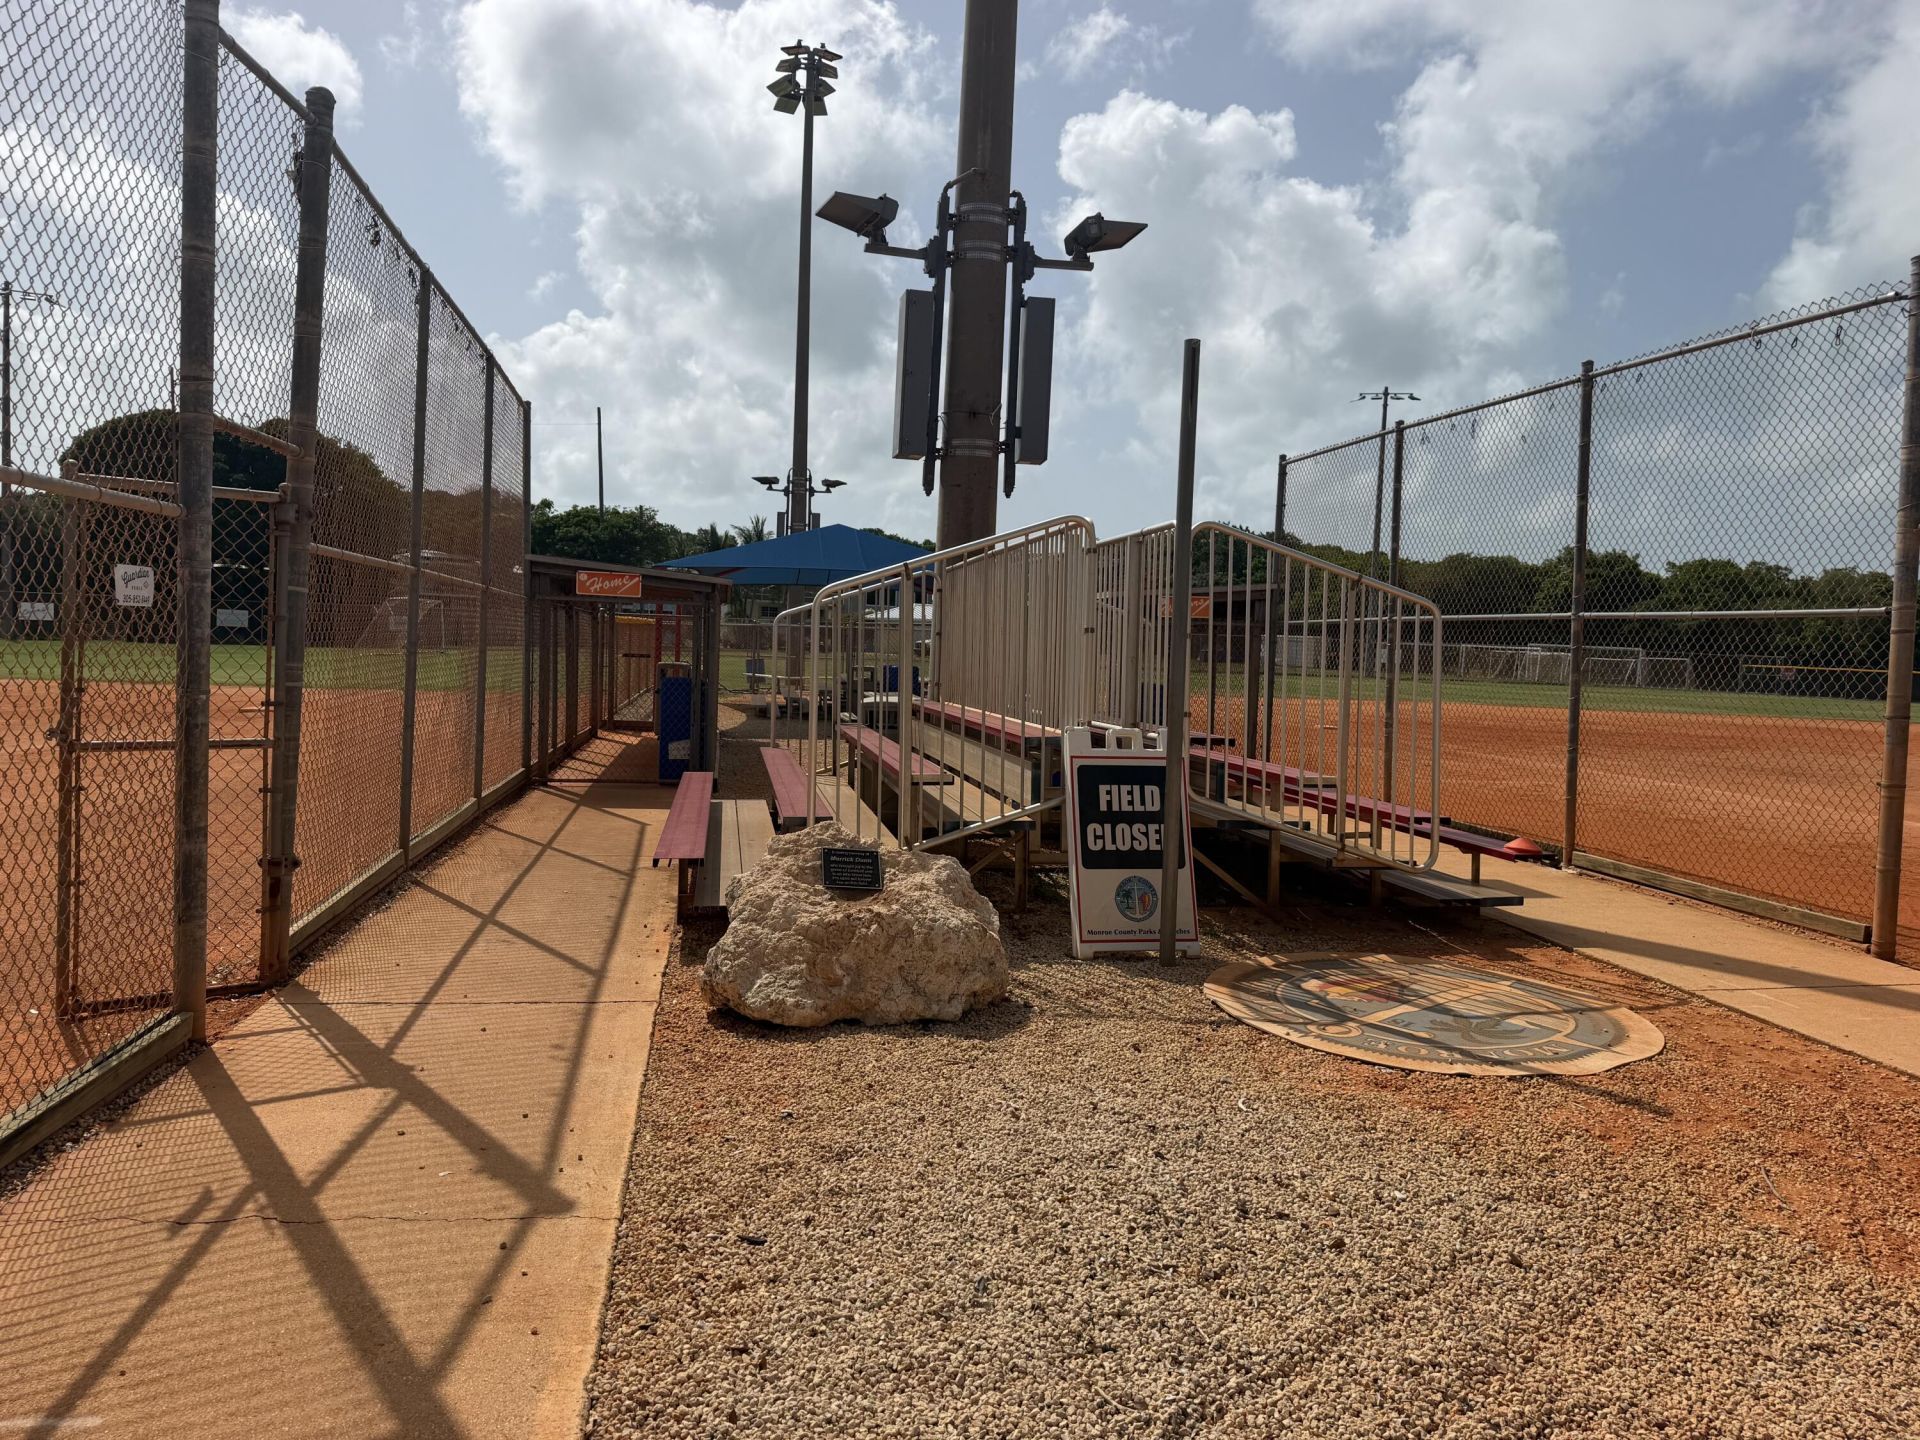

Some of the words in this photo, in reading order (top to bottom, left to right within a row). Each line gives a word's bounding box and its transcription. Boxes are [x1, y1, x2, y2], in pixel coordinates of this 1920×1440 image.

[587, 575, 632, 593] Home
[1099, 784, 1161, 811] FIELD
[1086, 822, 1165, 851] CLOSE
[1114, 929, 1137, 937] County
